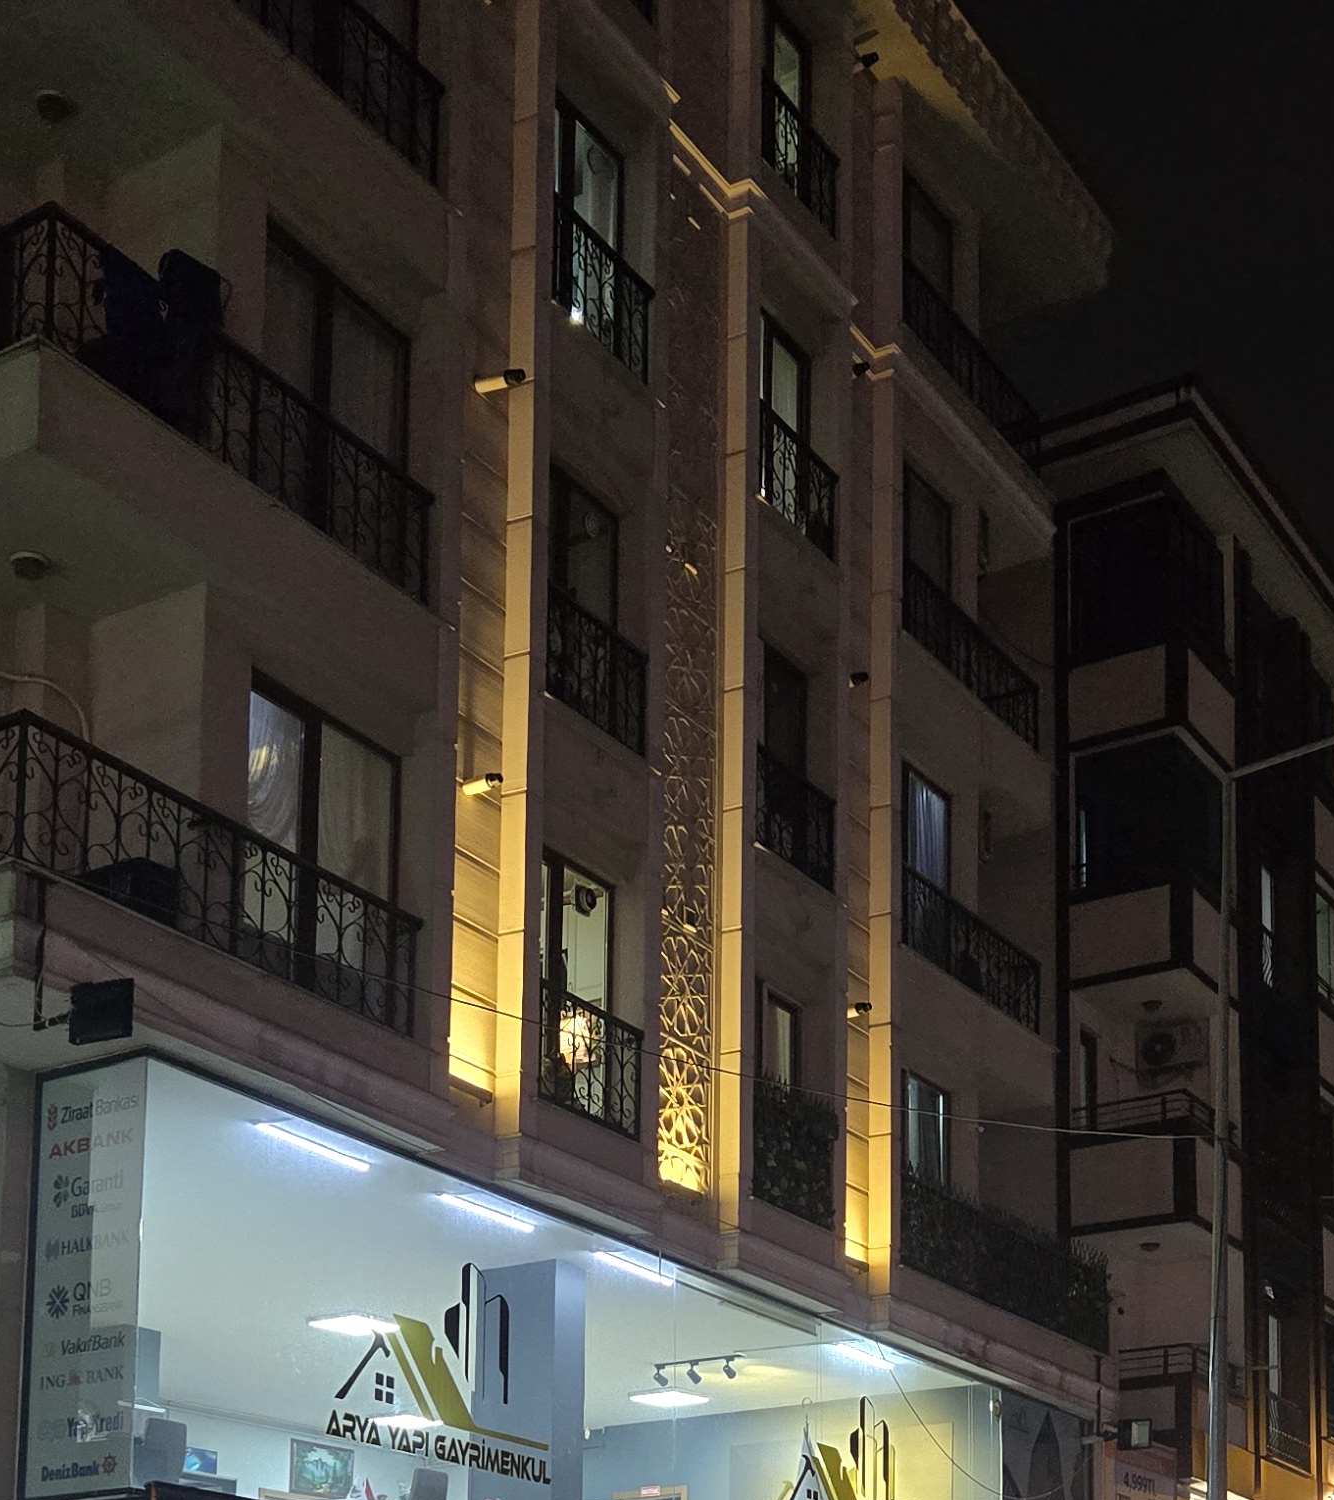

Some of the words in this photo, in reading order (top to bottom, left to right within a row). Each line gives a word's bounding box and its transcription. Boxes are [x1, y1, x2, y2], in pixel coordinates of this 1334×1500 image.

[61, 1102, 93, 1124] Ziraat
[49, 1127, 135, 1159] AKBANK
[71, 1169, 125, 1198] Garanti
[61, 1230, 130, 1256] HALKBANK
[73, 1278, 111, 1301] QNB
[40, 1375, 65, 1390] ING
[86, 1365, 124, 1385] BANK
[326, 1410, 382, 1446] ARYA
[388, 1425, 429, 1457] YAPI
[435, 1436, 551, 1484] GAYRİMENKUL
[41, 1461, 100, 1482] DenizBank
